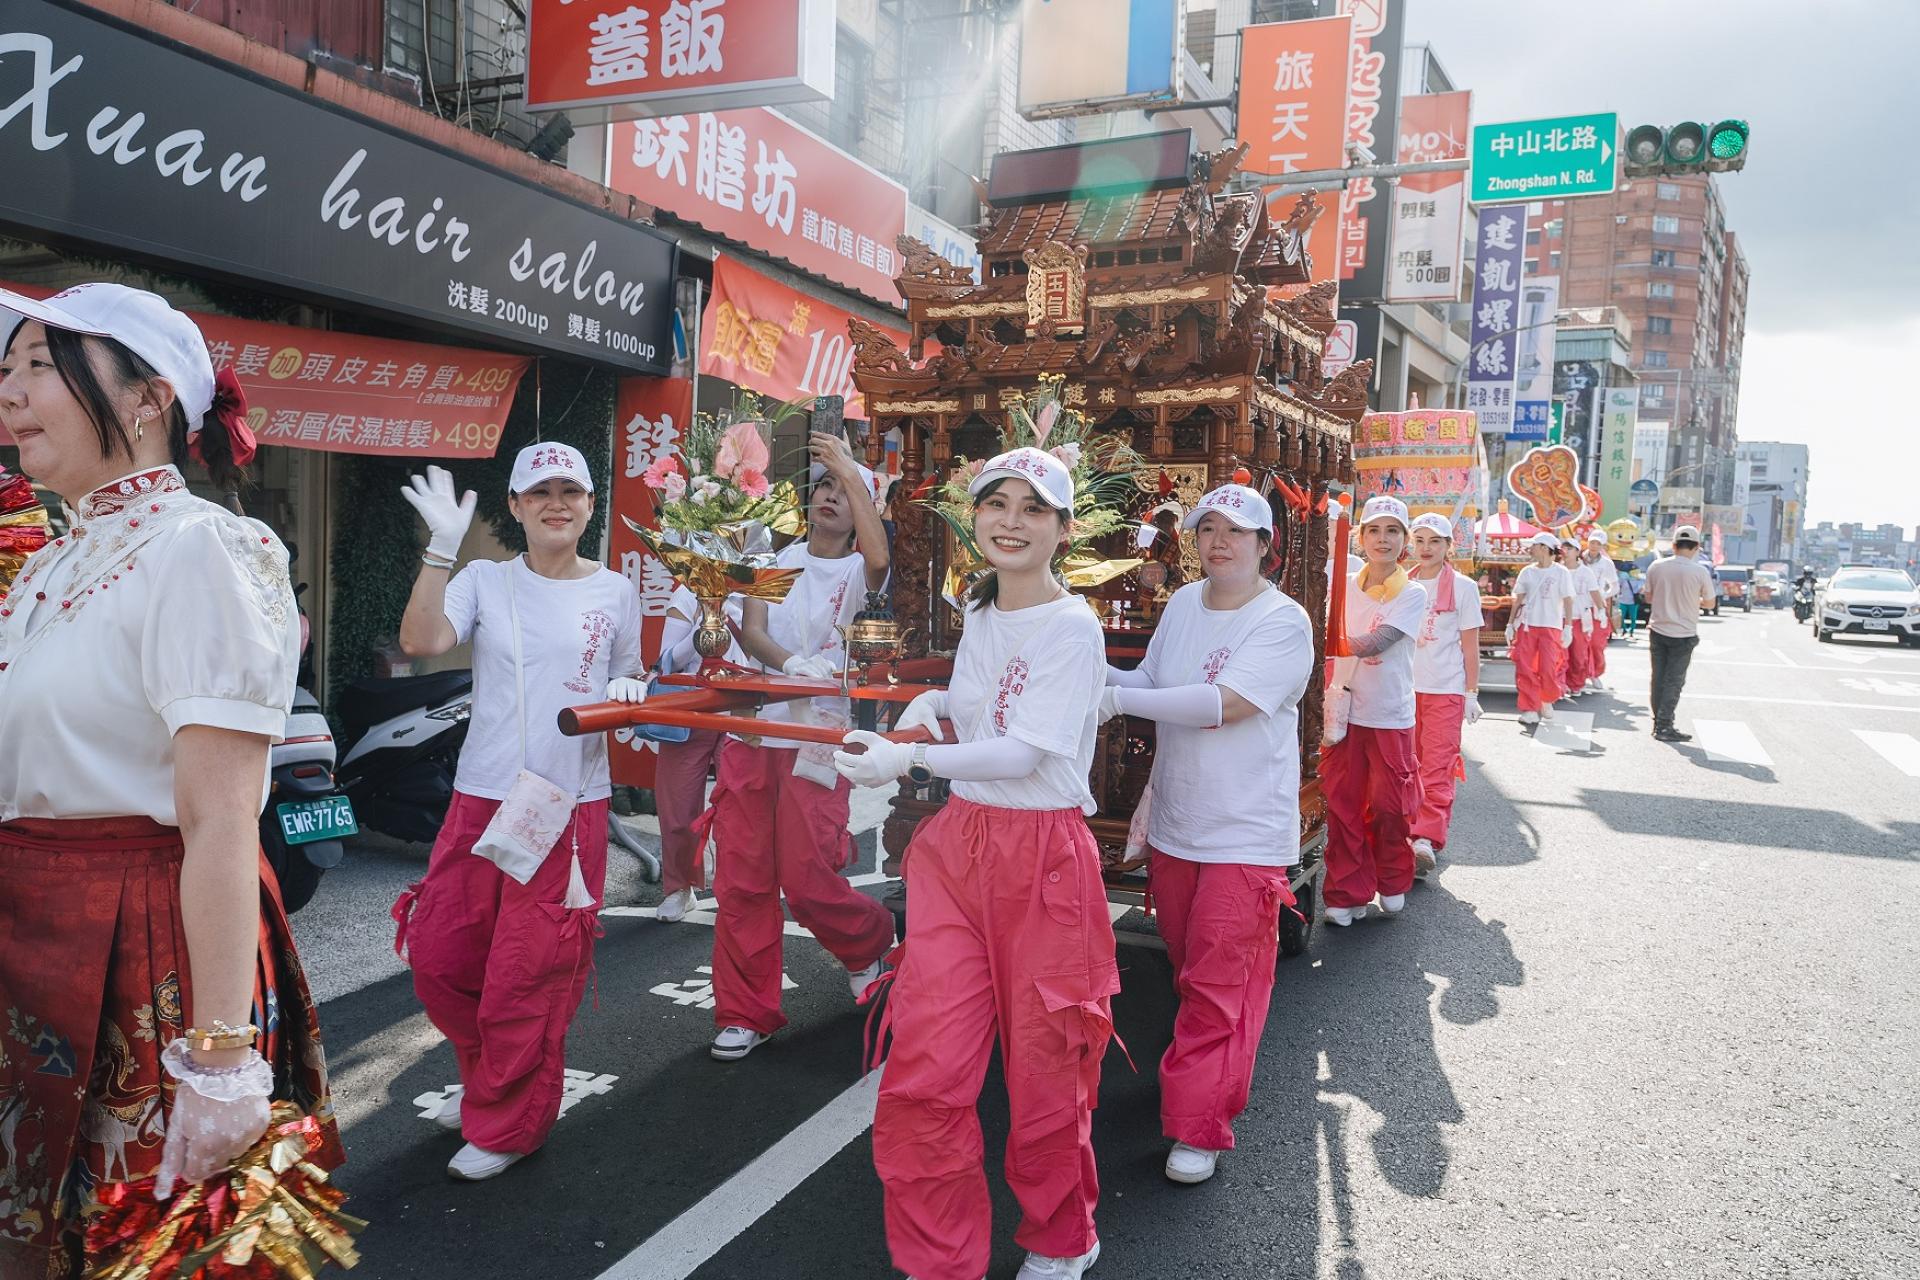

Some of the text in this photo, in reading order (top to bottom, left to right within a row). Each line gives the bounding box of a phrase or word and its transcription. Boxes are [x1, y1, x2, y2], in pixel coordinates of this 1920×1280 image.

[586, 0, 727, 86] 蓋飯
[1400, 131, 1441, 152] MO
[1490, 125, 1598, 158] 中山北路
[0, 33, 645, 316] Xuan hair salon
[1487, 169, 1597, 192] Zhongshan N. Rd.
[447, 280, 656, 362] 洗髮 200up 燙髮 1000up
[446, 423, 501, 450] 499
